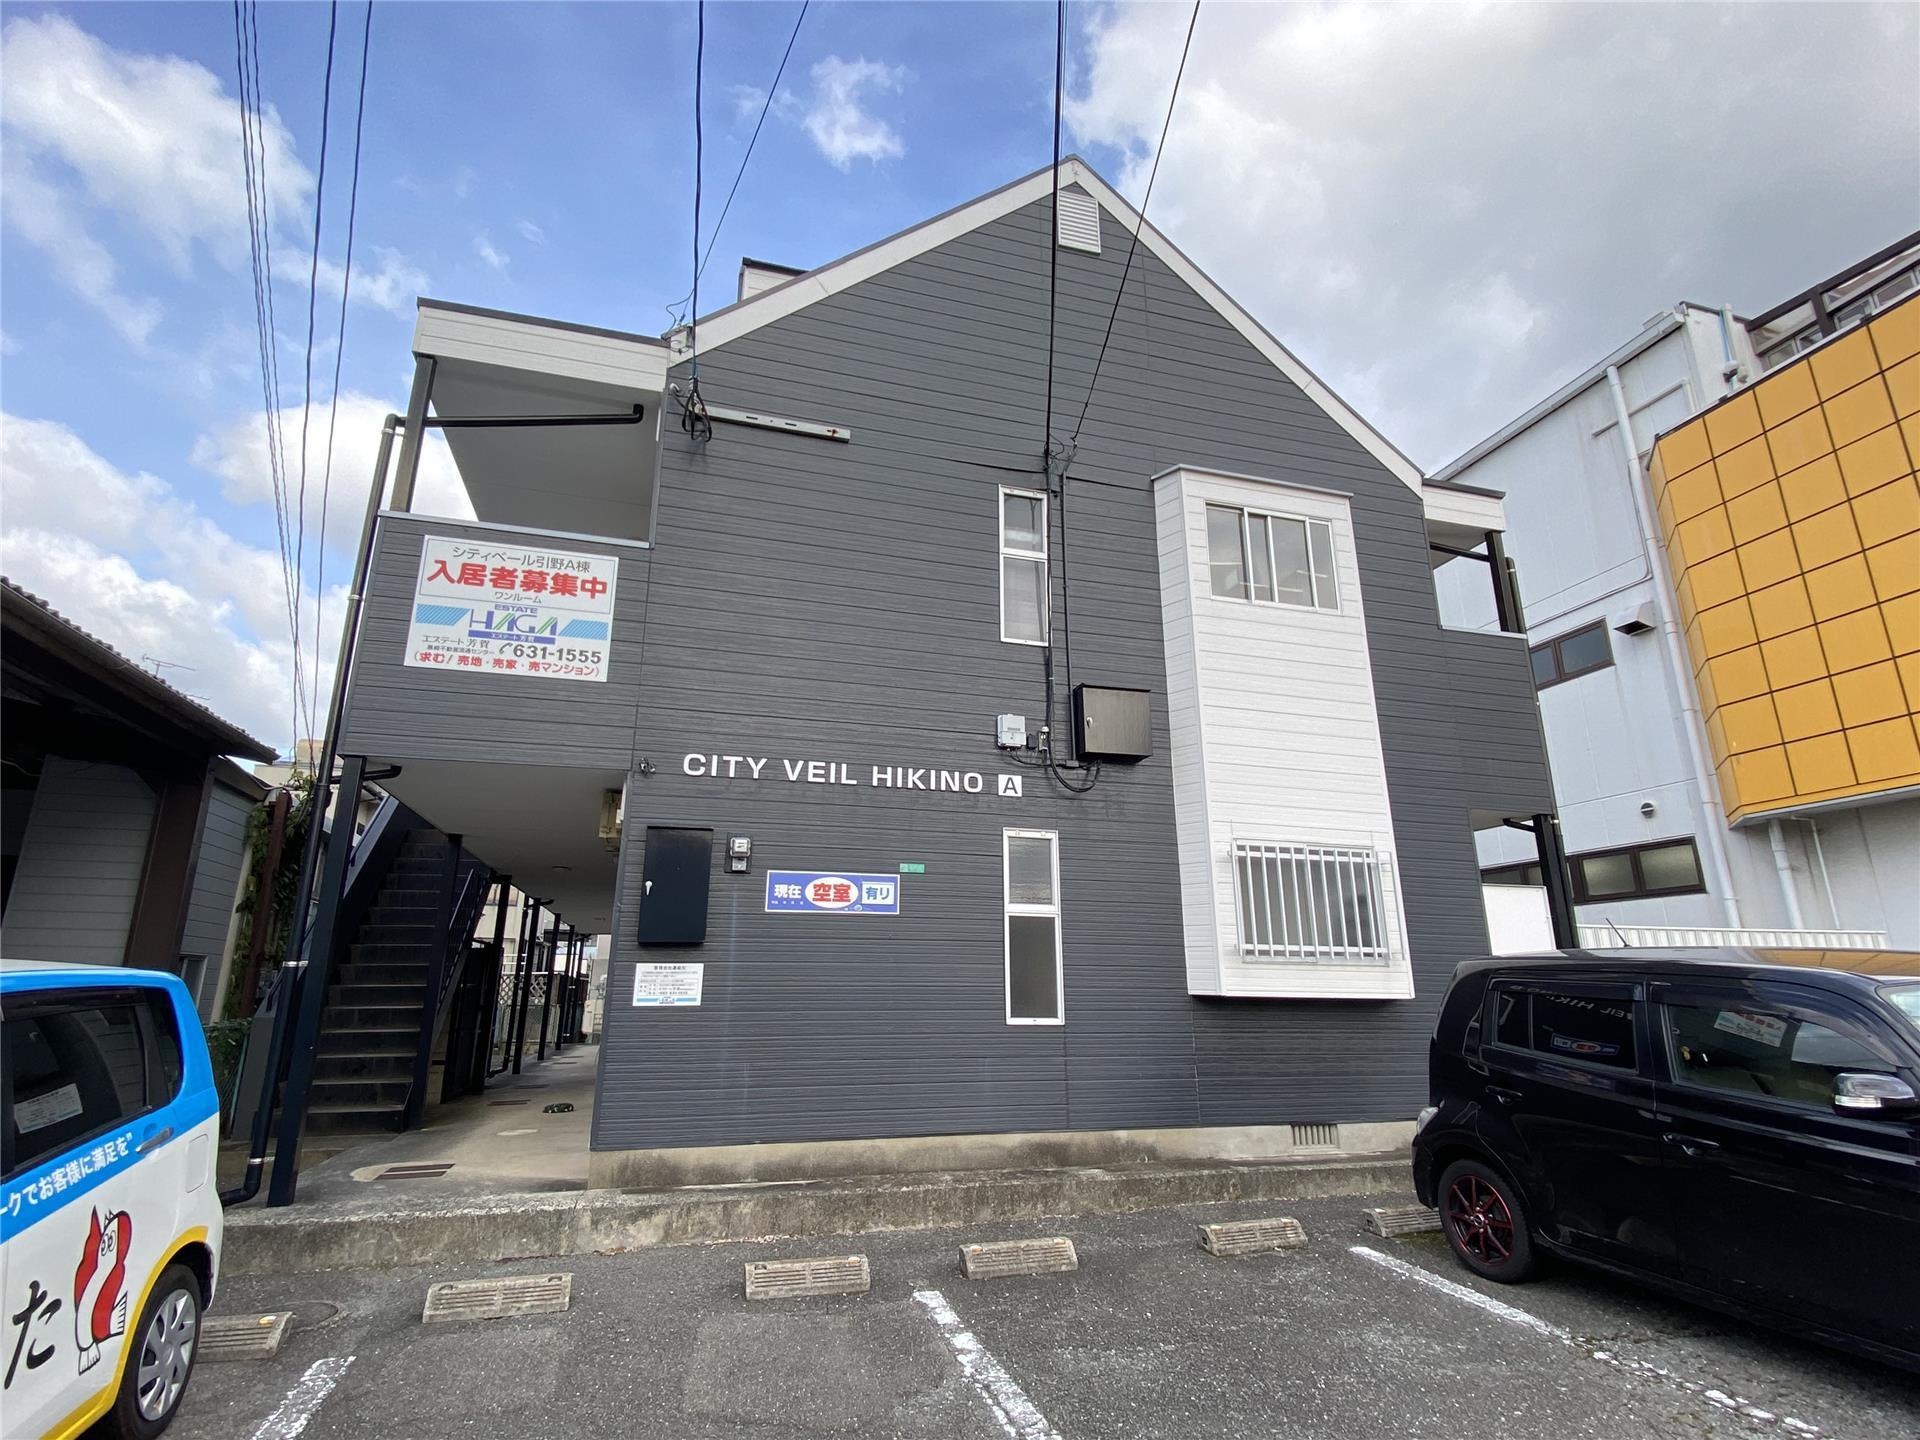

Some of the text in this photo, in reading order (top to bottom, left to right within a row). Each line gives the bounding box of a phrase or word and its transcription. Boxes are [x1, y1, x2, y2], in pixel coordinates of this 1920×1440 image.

[451, 546, 591, 574] シティベール引野A棟
[427, 559, 608, 600] 入居者募集中
[494, 591, 542, 604] ワンルーム
[494, 603, 538, 614] ESTATE
[468, 608, 559, 637] HAGA
[513, 644, 603, 665] 631-1555
[682, 753, 1019, 795] CITY VEIL HIKINO A
[773, 883, 890, 903] 現在 空室 有り
[3, 1279, 63, 1390] た
